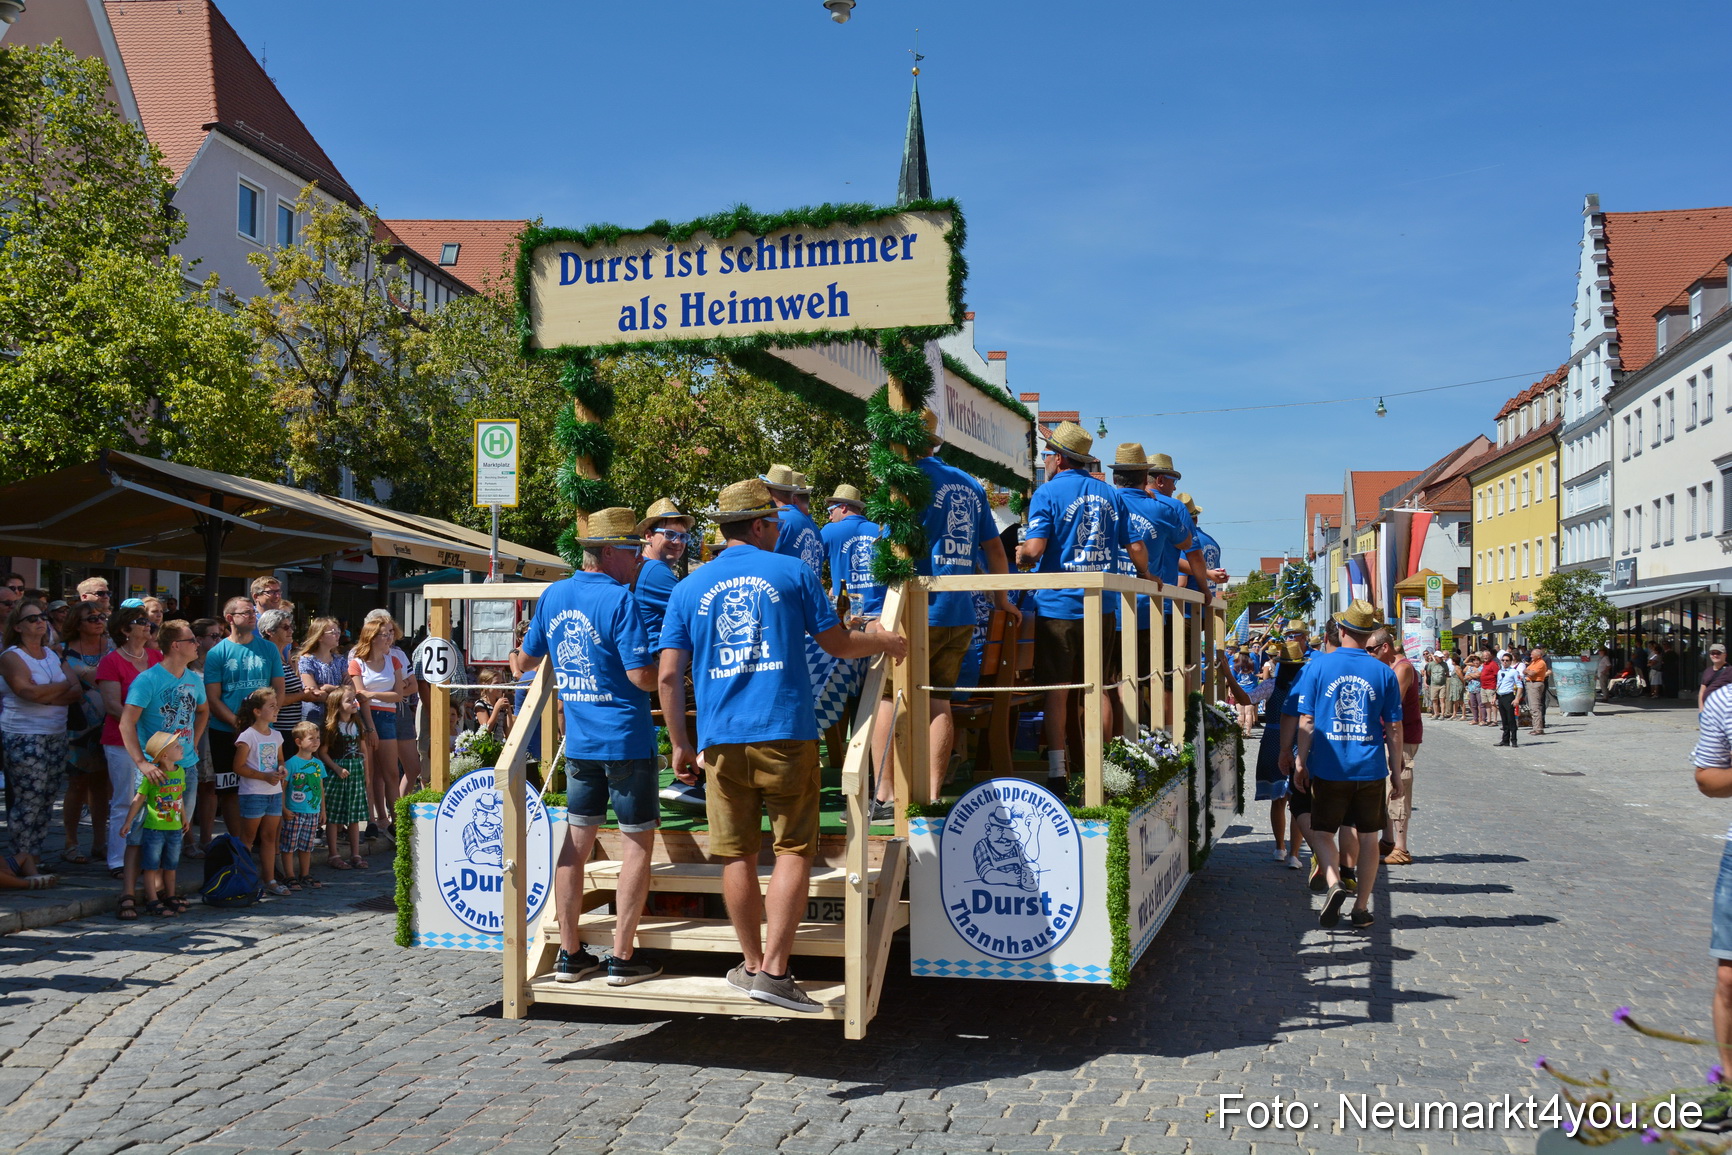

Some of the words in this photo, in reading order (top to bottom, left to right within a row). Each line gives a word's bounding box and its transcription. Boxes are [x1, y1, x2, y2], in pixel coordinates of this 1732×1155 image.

[559, 249, 653, 286] Durst
[664, 244, 708, 278] ist
[719, 233, 918, 274] schlimmer
[618, 295, 668, 332] als
[680, 281, 850, 328] Heimweh
[1074, 547, 1112, 563] Durst
[698, 576, 780, 616] Frühschoppenverein
[424, 645, 449, 676] 25
[719, 640, 770, 666] Durst
[1324, 675, 1376, 702] Frühschoppenverein
[1326, 732, 1374, 742] Thannhausen
[1332, 721, 1368, 734] Durst
[948, 786, 1070, 837] Frühschoppenverein
[461, 868, 504, 892] Dur
[443, 876, 545, 928] Thannhen
[972, 889, 1052, 916] Durst
[950, 898, 1073, 954] Thannhausen
